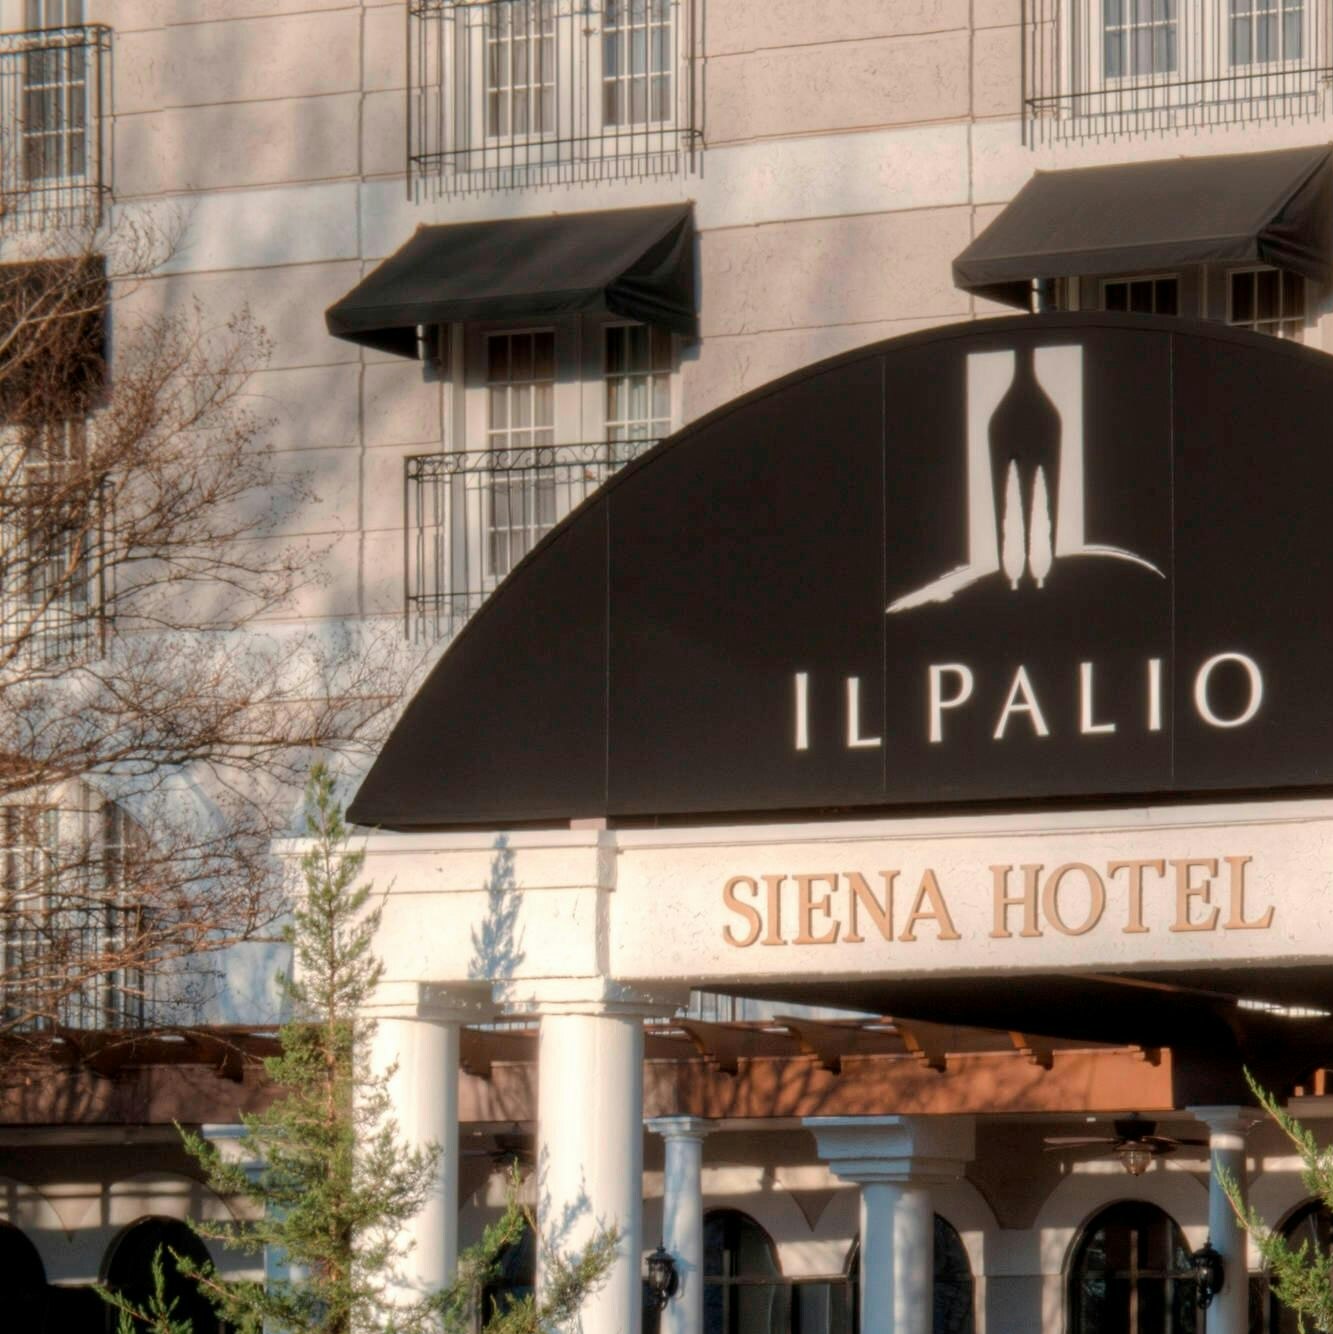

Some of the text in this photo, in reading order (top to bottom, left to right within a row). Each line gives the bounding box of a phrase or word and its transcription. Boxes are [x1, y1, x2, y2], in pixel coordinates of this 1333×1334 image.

[794, 653, 1265, 750] IL PALIO
[721, 856, 1276, 947] SIENA HOTEL
